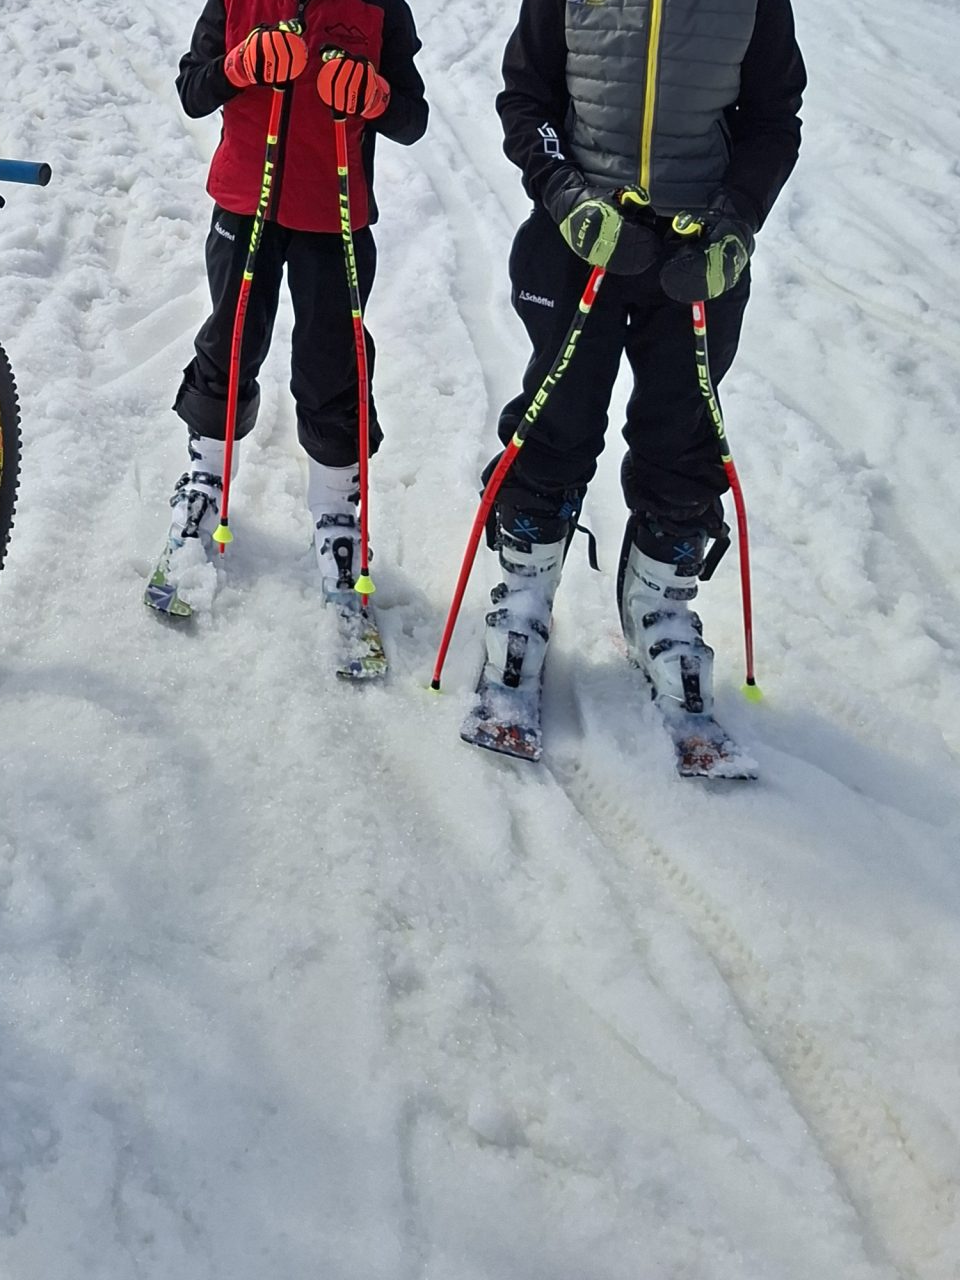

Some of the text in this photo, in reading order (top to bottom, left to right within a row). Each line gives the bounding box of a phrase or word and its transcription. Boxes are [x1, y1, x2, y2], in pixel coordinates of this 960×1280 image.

[260, 160, 274, 208] LEKI
[576, 217, 591, 248] LEKI
[554, 329, 582, 378] LEKI
[524, 375, 556, 423] LEKI
